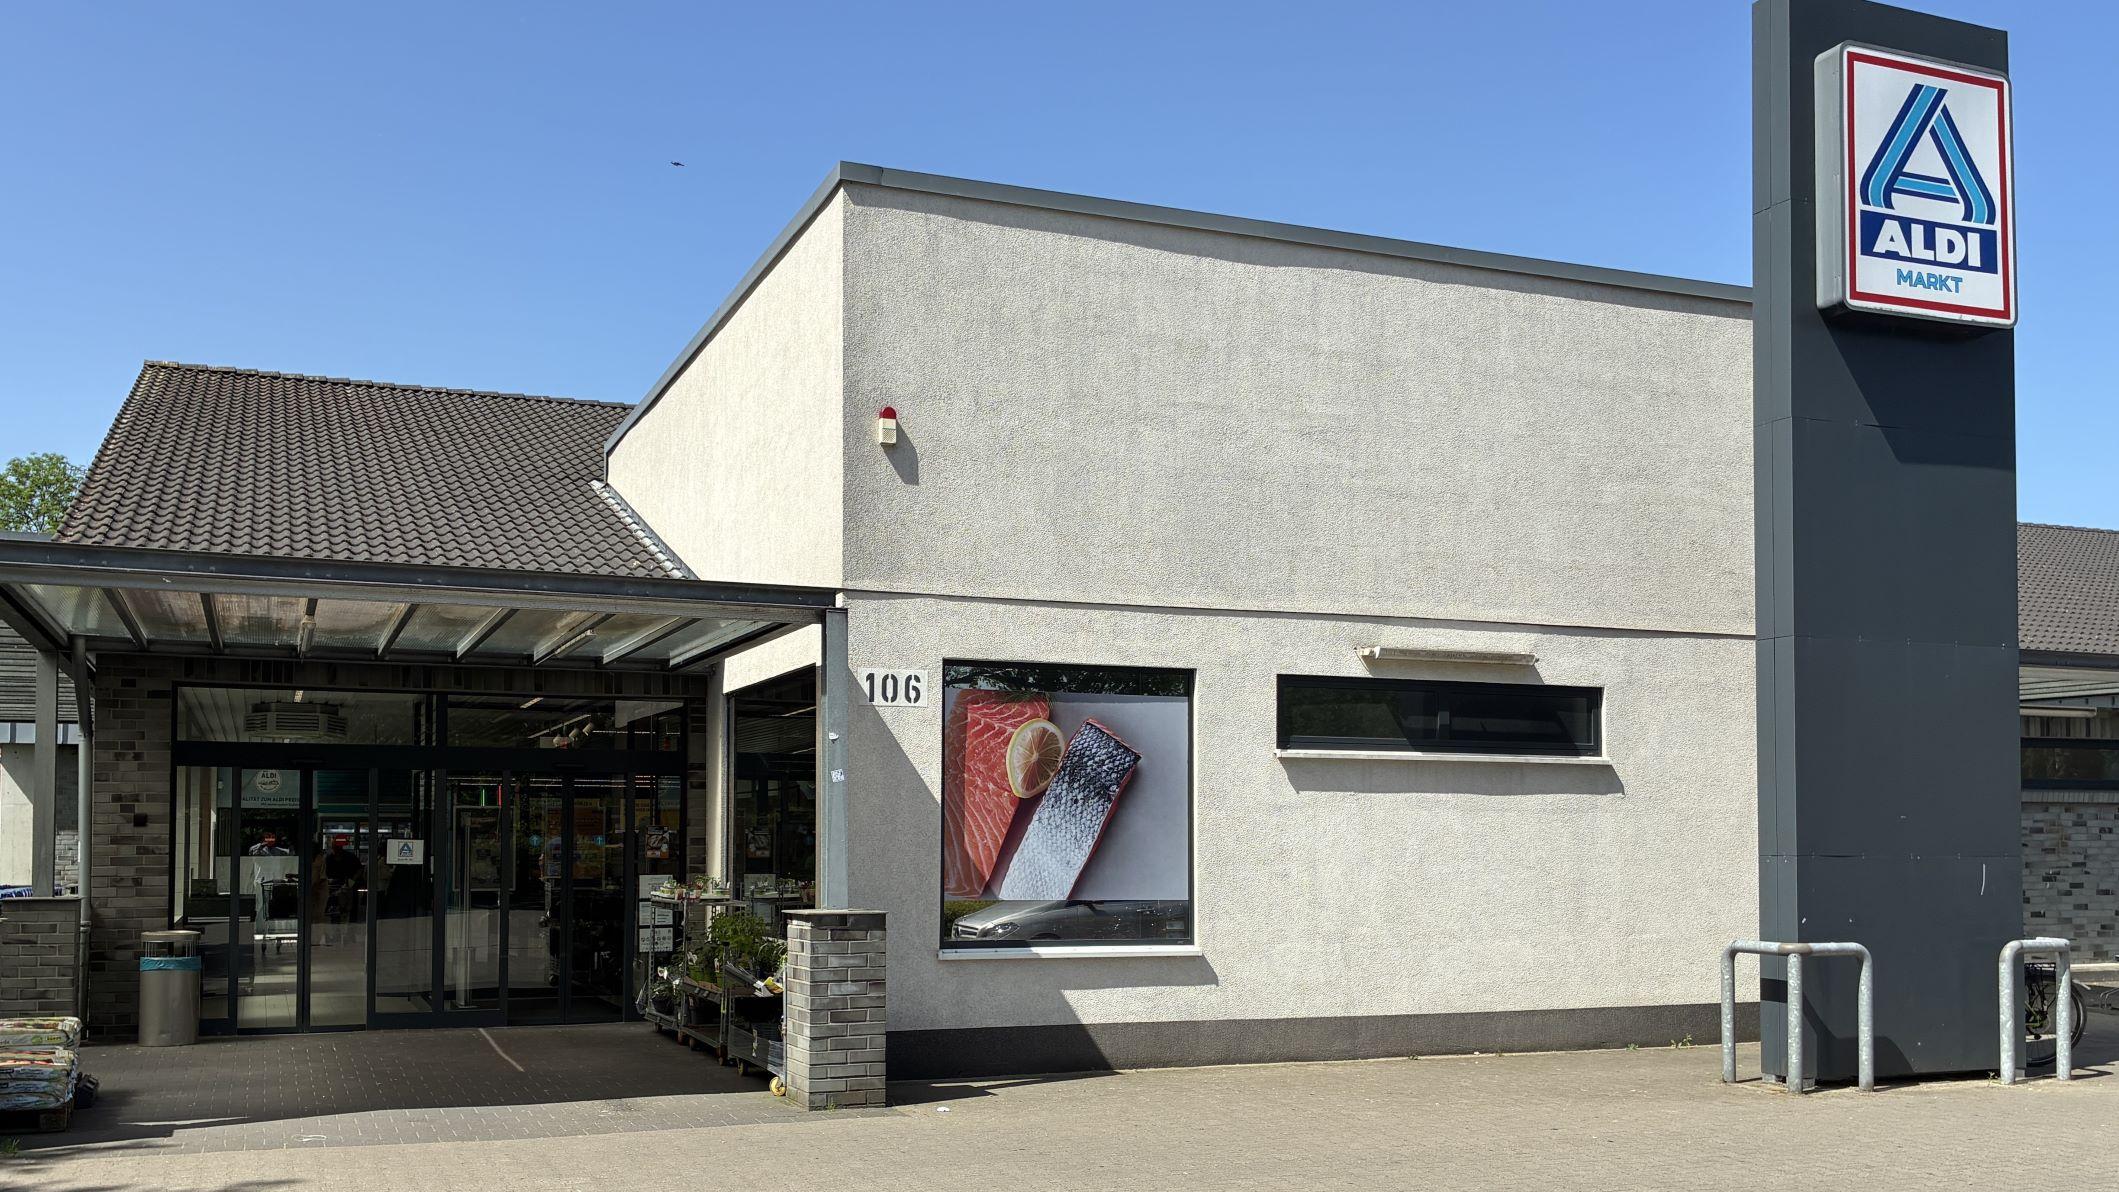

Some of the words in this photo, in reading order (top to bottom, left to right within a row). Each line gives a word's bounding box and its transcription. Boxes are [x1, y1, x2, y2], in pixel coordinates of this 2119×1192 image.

[1873, 219, 1981, 268] ALDI
[1896, 268, 1964, 293] MARKT
[866, 672, 921, 704] 106
